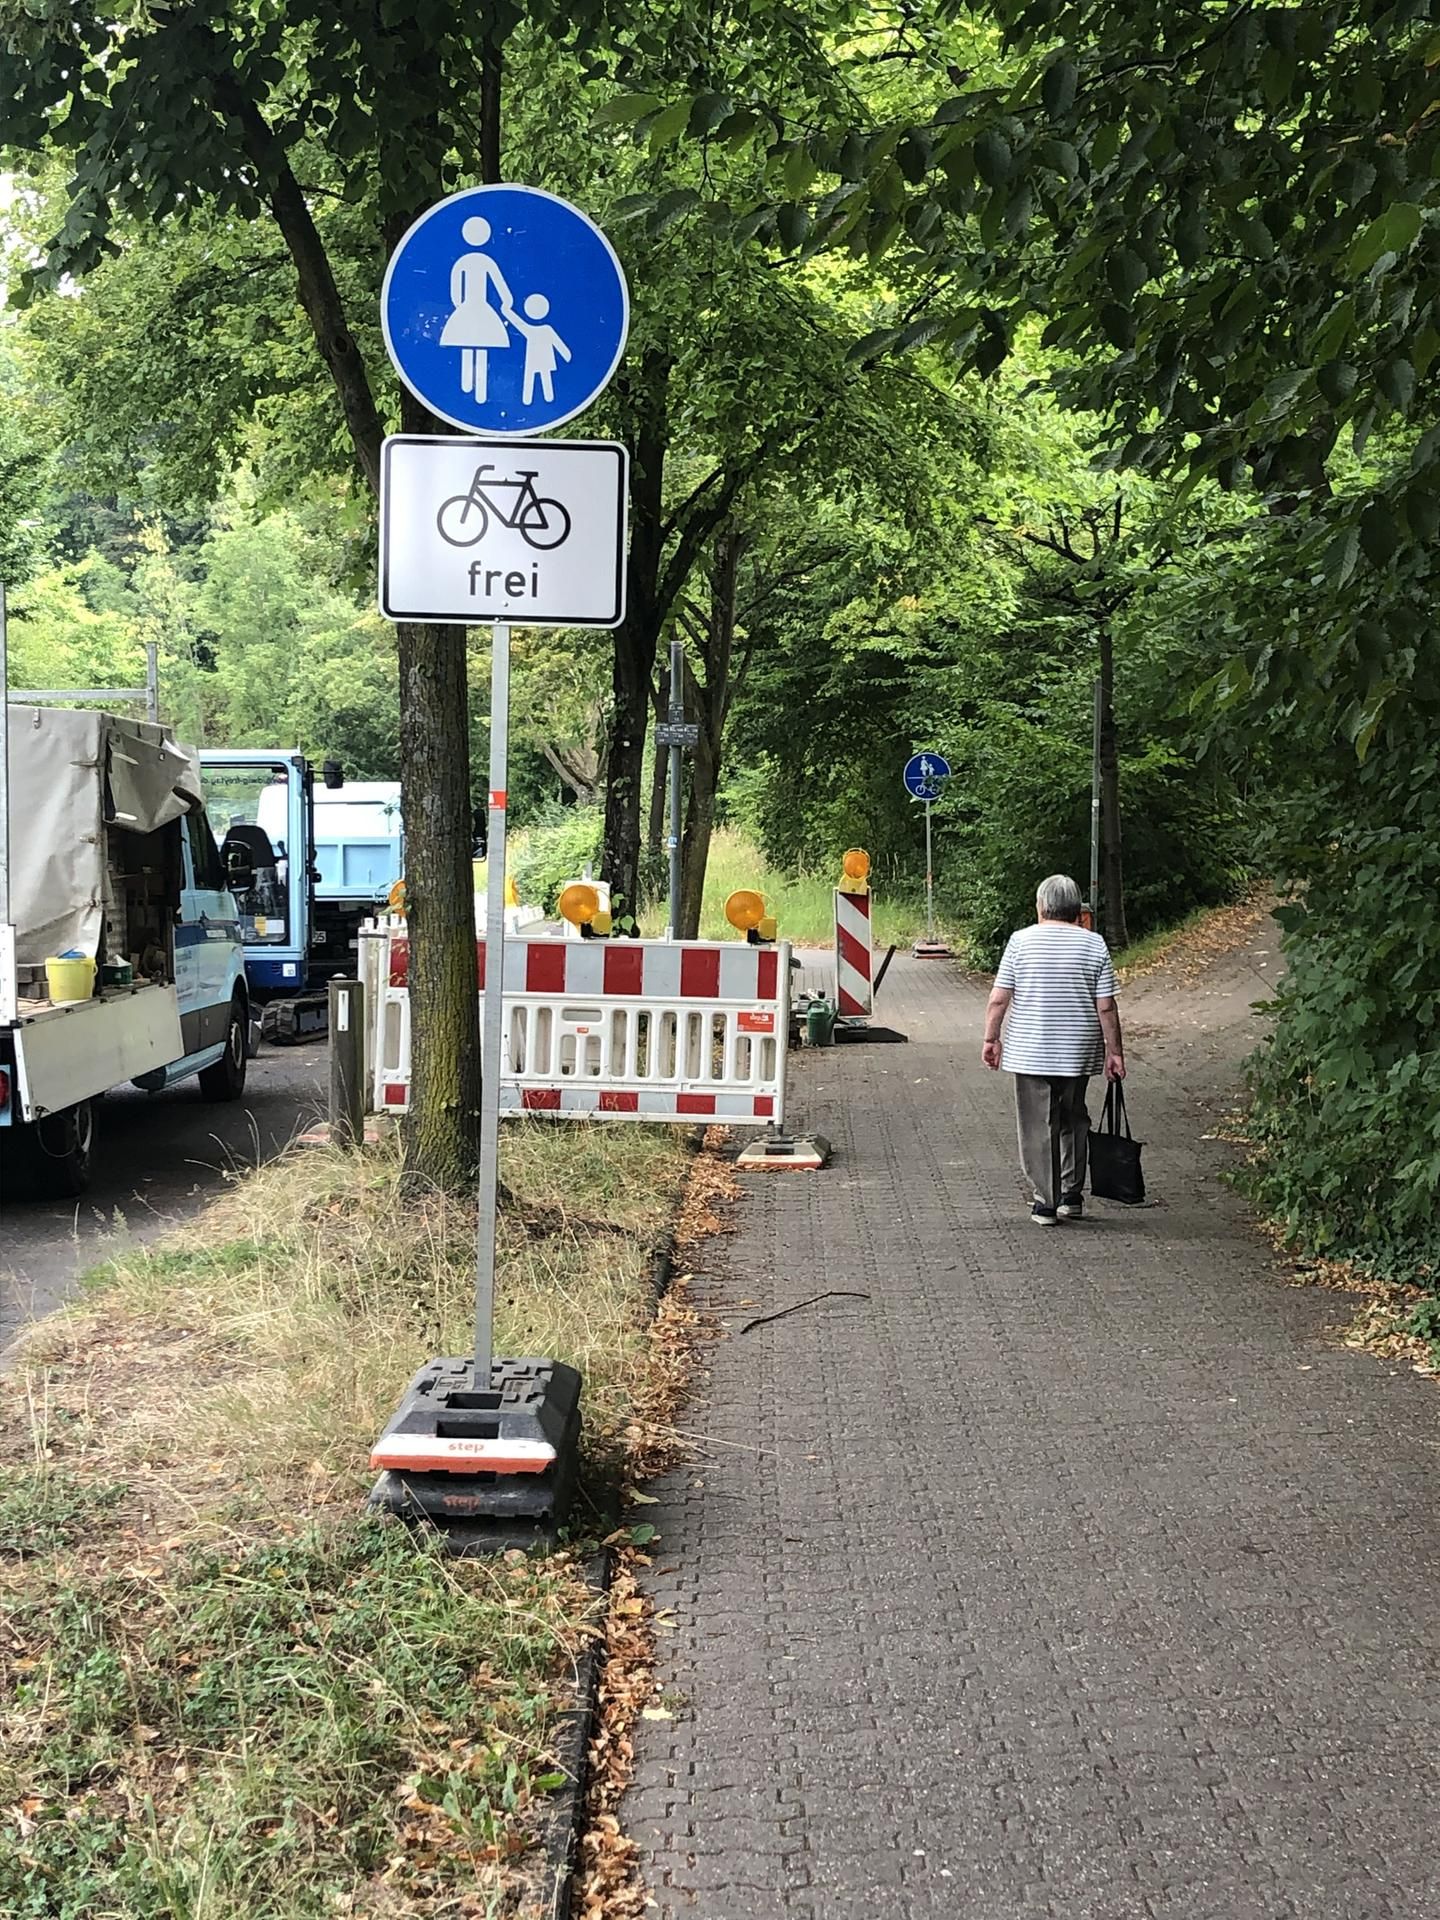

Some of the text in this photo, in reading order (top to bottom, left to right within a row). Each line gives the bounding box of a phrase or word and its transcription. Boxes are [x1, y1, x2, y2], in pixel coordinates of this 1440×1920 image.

[468, 560, 539, 598] frei
[448, 1442, 484, 1454] step
[443, 1495, 481, 1511] step
